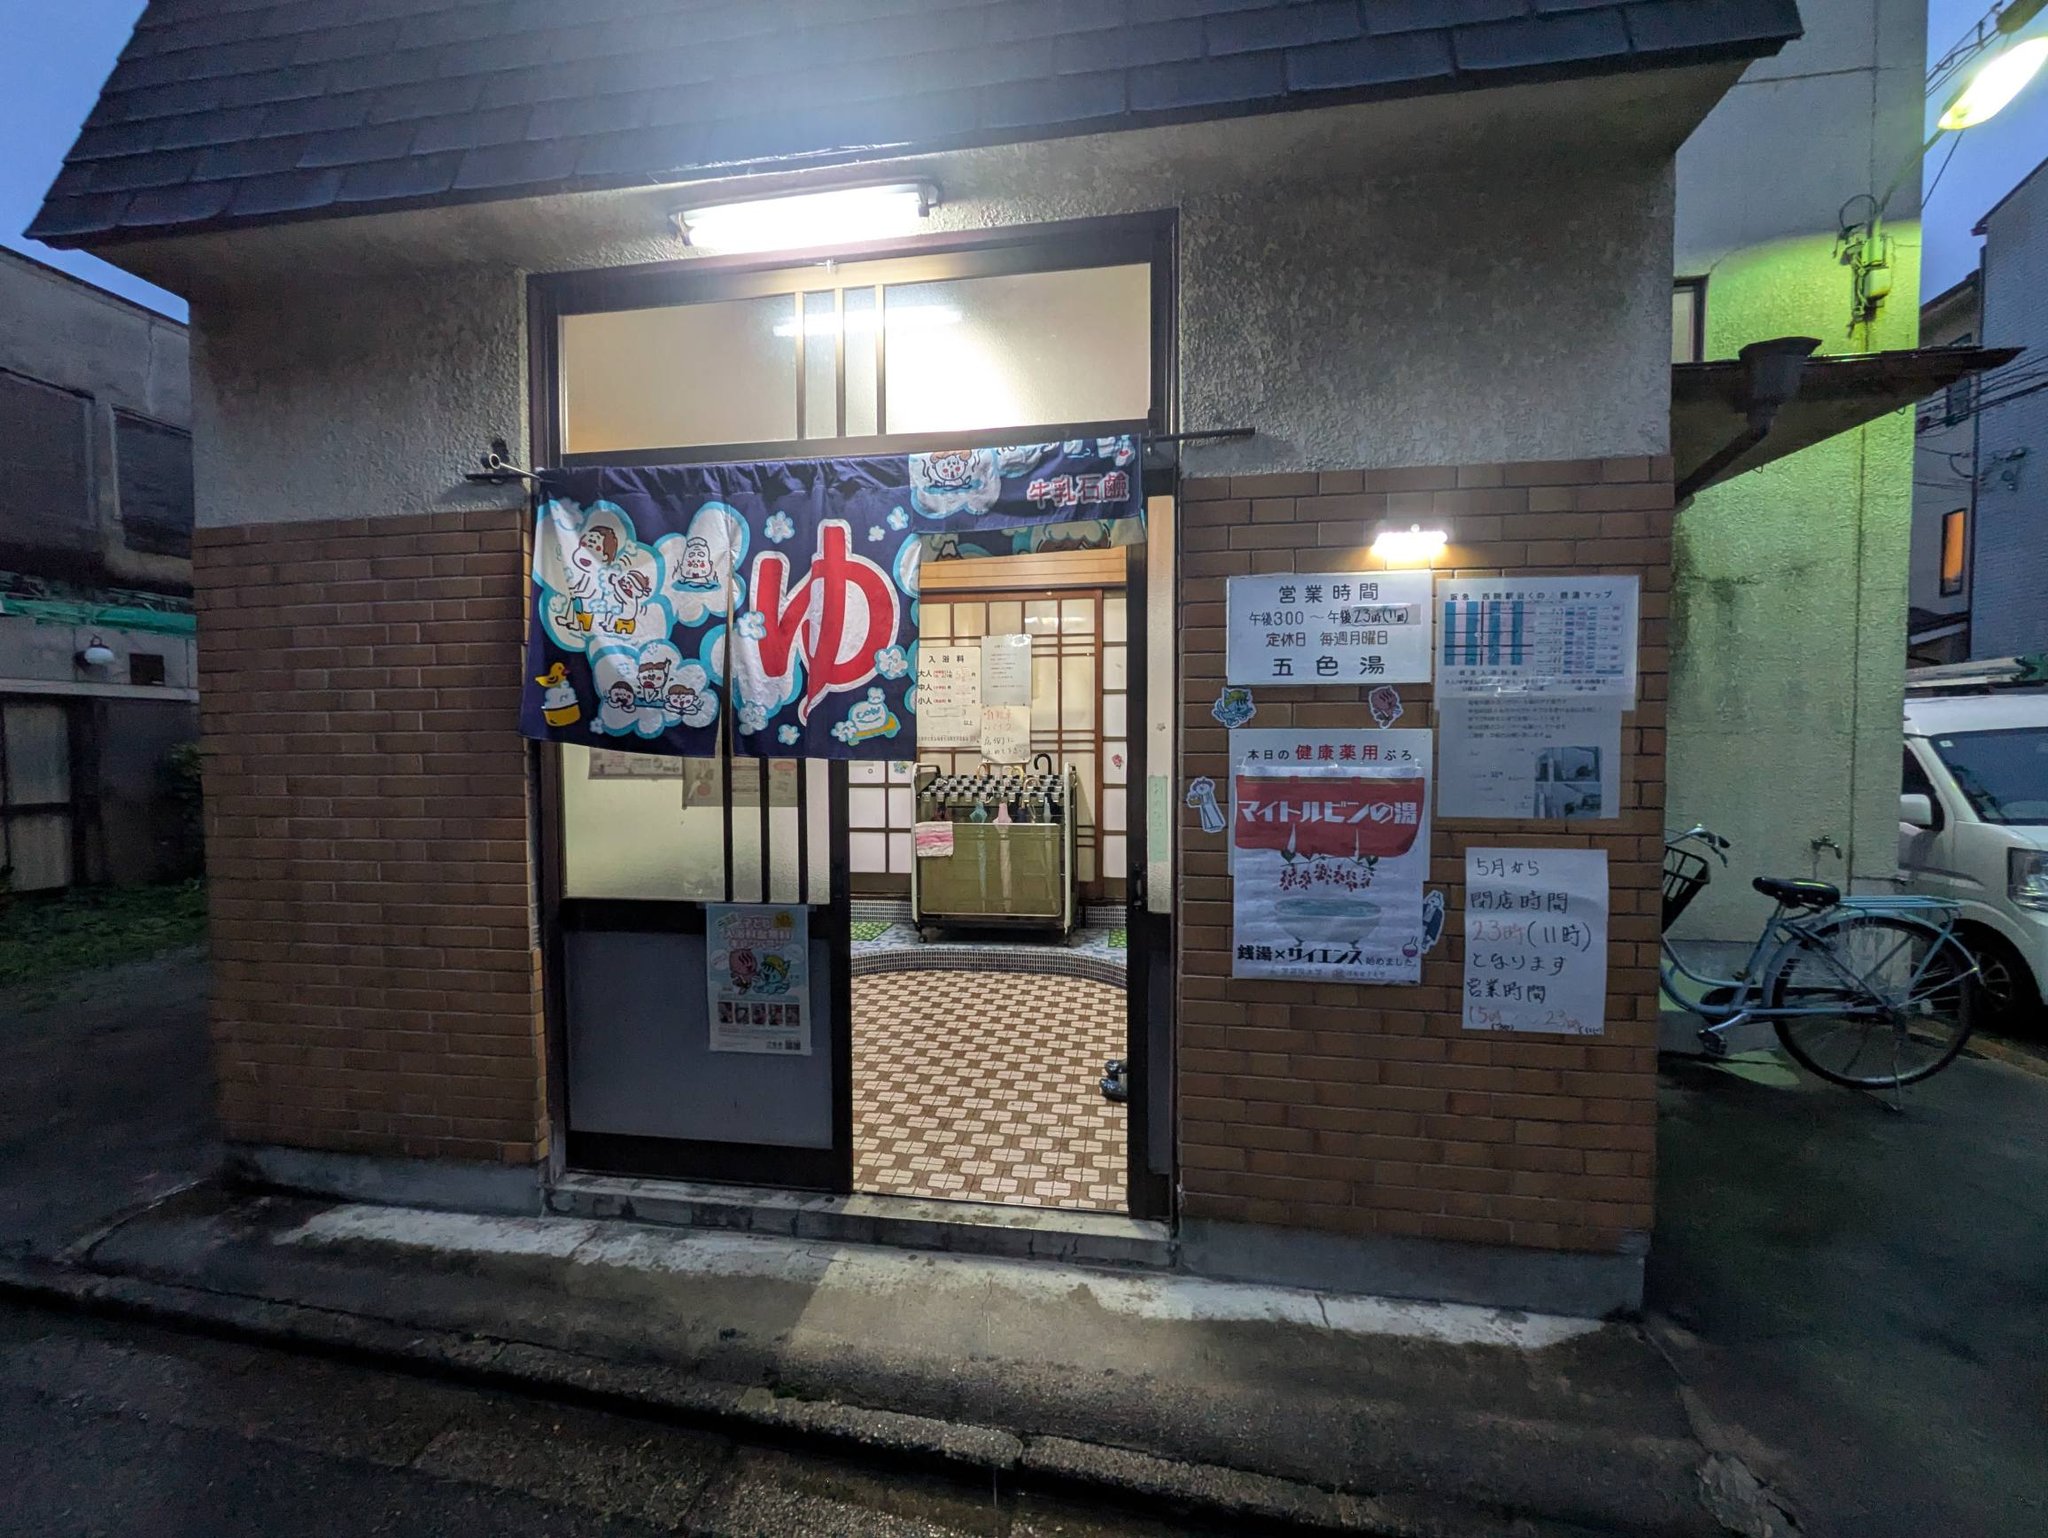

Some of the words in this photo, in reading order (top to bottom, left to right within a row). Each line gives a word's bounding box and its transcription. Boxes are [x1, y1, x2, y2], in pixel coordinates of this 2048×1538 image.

[1279, 583, 1378, 604] 営業時間
[752, 520, 899, 725] ゆ
[1265, 632, 1306, 647] 定休日
[1320, 630, 1388, 646] 毎週月曜日
[1272, 655, 1386, 677] 五色湯
[1238, 800, 1417, 825] マイトルビンの湯
[1477, 857, 1540, 878] 5月から
[1470, 890, 1569, 914] 閉店時間
[1473, 953, 1566, 976] となります
[1466, 977, 1546, 1004] 営業時間
